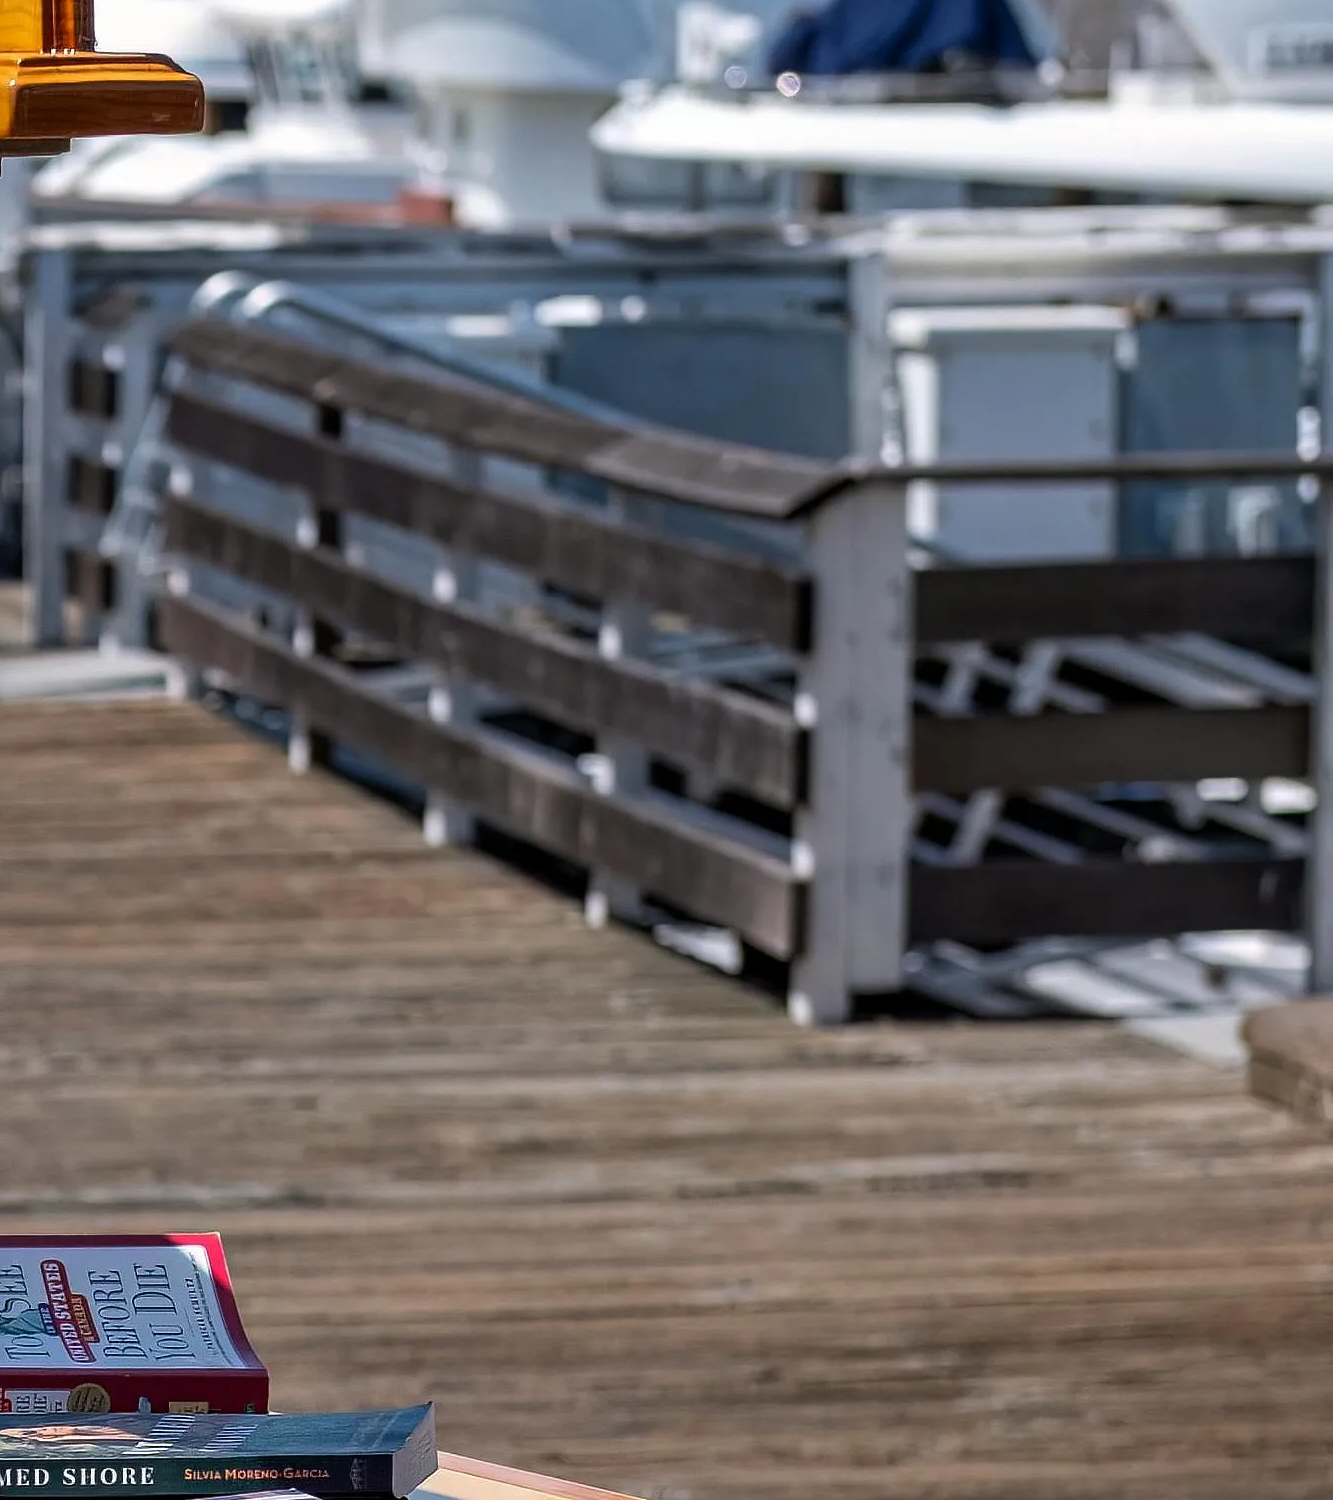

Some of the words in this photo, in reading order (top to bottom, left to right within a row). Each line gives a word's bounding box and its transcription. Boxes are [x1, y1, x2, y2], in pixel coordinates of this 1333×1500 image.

[43, 1261, 73, 1321] STATES
[132, 1262, 179, 1316] DIE
[87, 1269, 149, 1360] BEFORE
[58, 1320, 91, 1363] UNITED
[148, 1323, 197, 1361] YOU
[62, 1466, 155, 1486] SHORE
[183, 1467, 221, 1482] SILVIA
